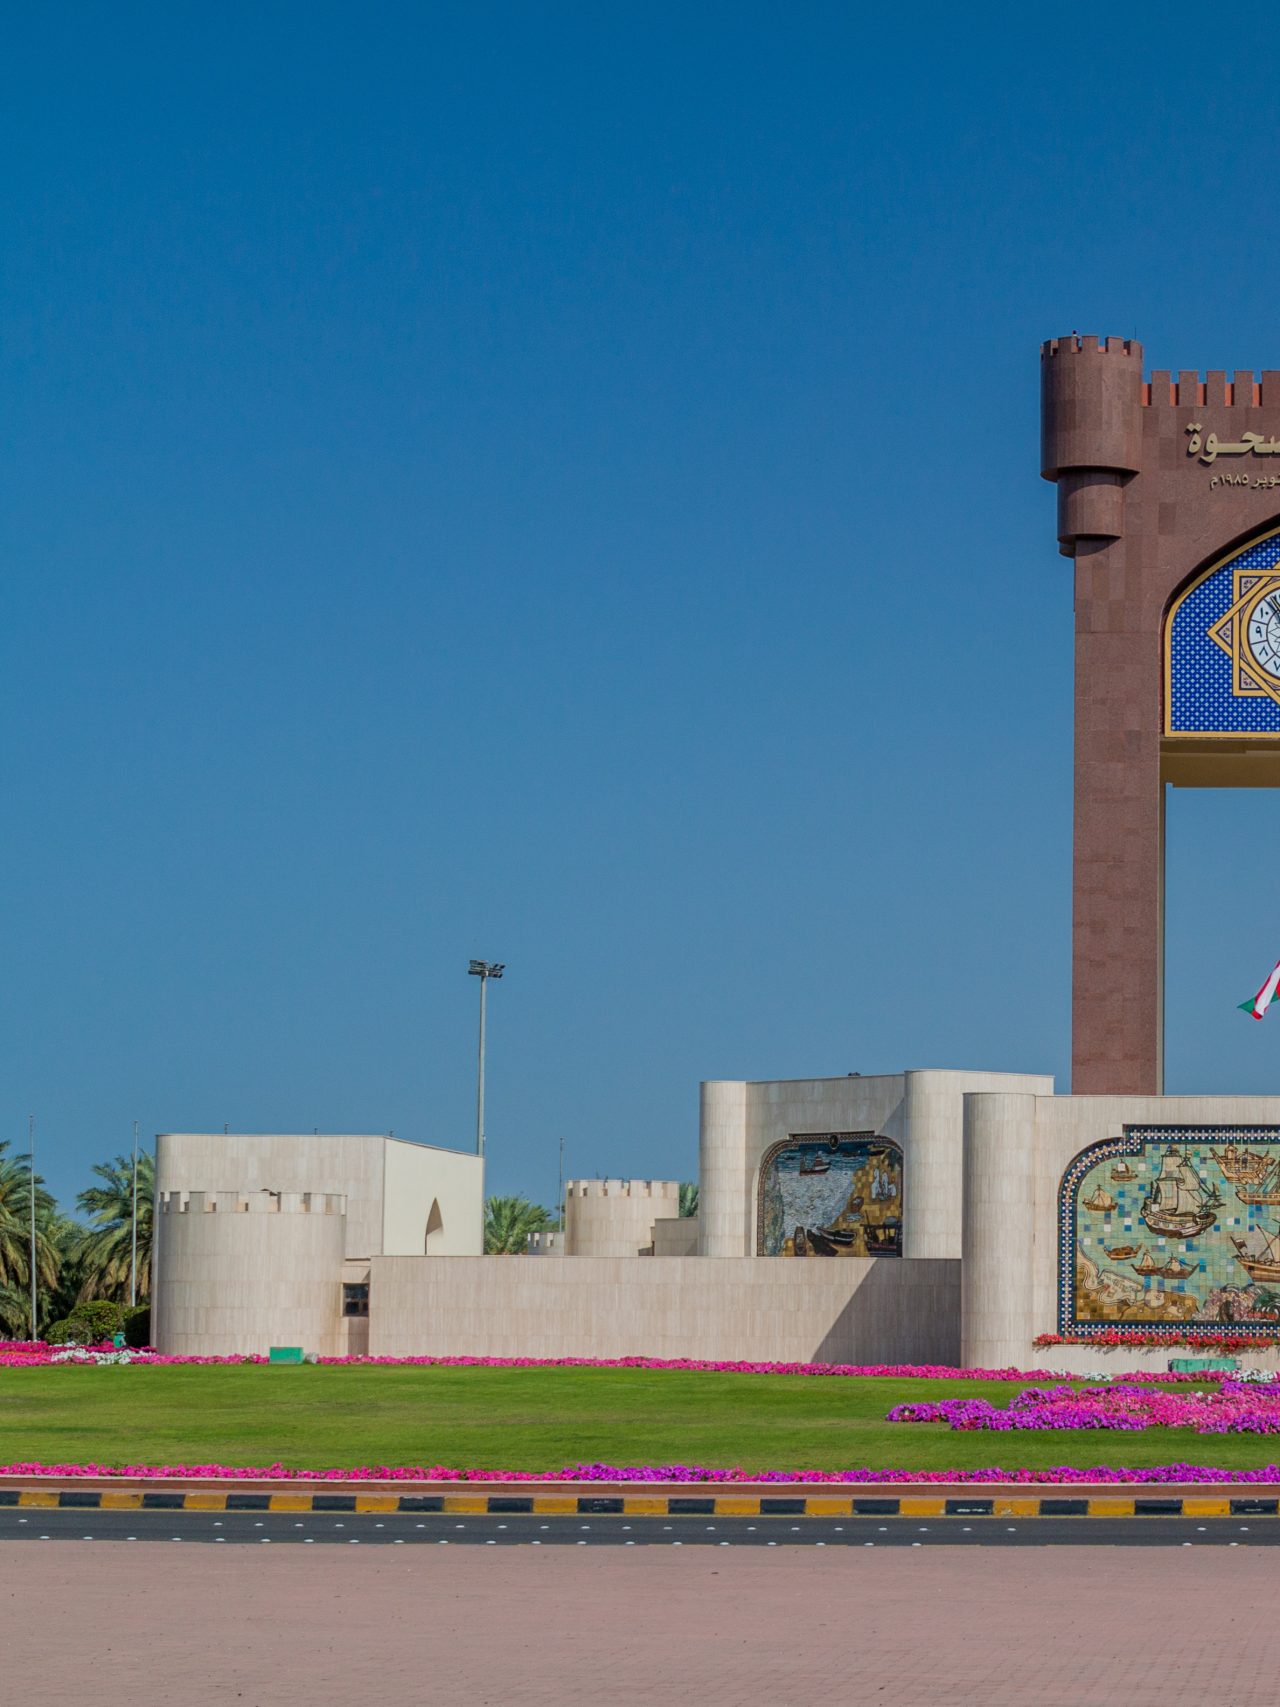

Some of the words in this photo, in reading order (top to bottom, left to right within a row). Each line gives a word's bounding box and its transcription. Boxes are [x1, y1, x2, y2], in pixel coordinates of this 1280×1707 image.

[1260, 607, 1269, 619] ١٠
[1255, 626, 1262, 638] ٩
[1258, 646, 1269, 656] ٨
